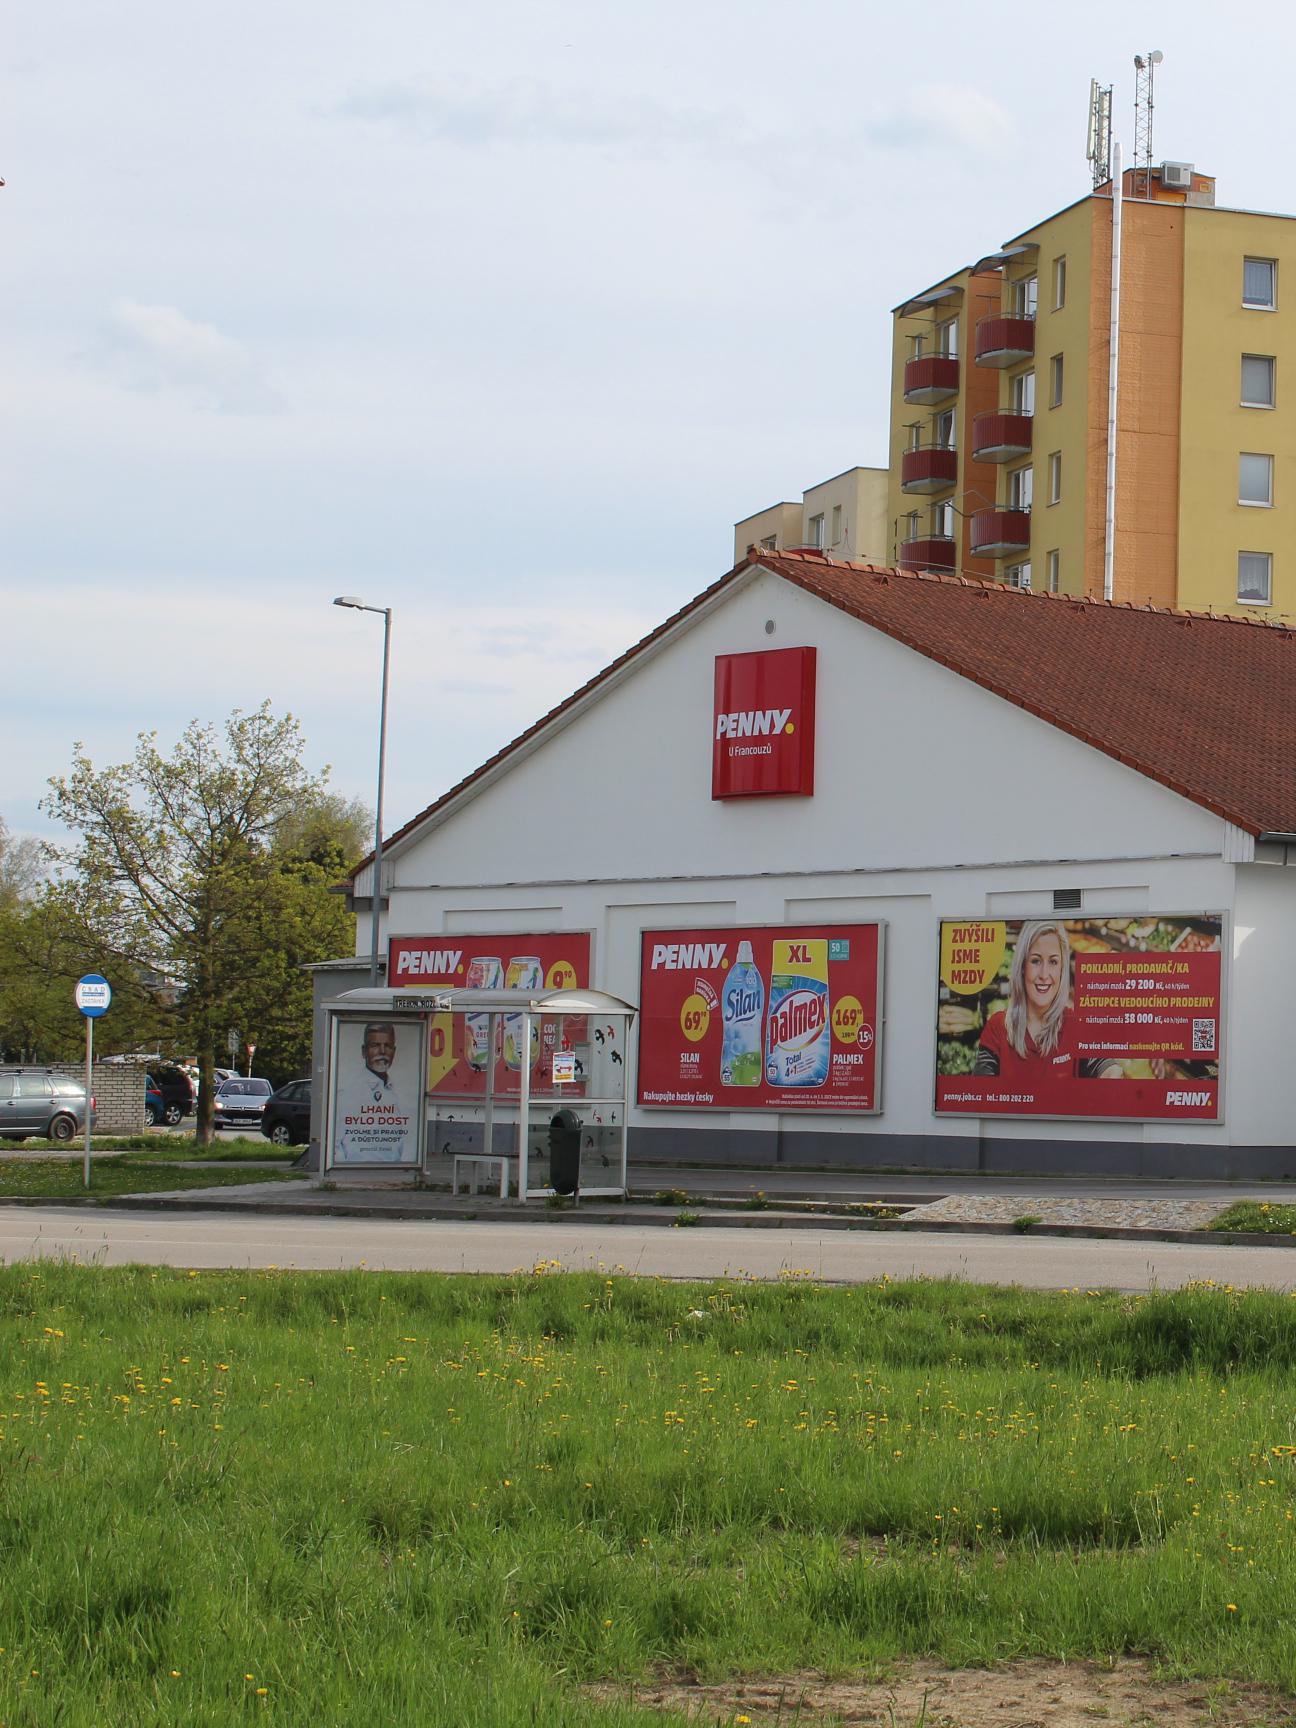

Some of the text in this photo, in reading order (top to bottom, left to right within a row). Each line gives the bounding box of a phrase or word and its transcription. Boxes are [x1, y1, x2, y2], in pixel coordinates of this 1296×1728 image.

[728, 743, 772, 756] U Francouzů
[951, 923, 995, 943] ZVÝŠILI
[788, 944, 812, 963] XL
[951, 948, 981, 964] JSME
[1080, 961, 1190, 975] POKLADNÍ, PRODAVAČ/KA
[951, 969, 985, 984] MZDY
[1125, 979, 1136, 989] 29
[1138, 979, 1154, 989] 200
[725, 988, 760, 1022] Silan
[1079, 995, 1214, 1008] ZÁSTUPCE VEDOUCÍHO PRODEJNY
[770, 993, 826, 1054] palmex
[1124, 1013, 1135, 1023] 38
[1136, 1013, 1154, 1023] 000
[1078, 1042, 1088, 1050] Pro
[1089, 1042, 1101, 1050] více
[1101, 1042, 1129, 1050] informací
[1161, 1043, 1170, 1051] QR
[1170, 1042, 1184, 1050] kód.
[680, 1053, 700, 1063] SILAN
[785, 1051, 802, 1066] Total
[832, 1054, 864, 1065] PALMEX
[643, 1091, 714, 1104] Nakupujte hezky česky
[360, 1104, 395, 1113] LHANÍ
[345, 1116, 410, 1125] BYLO DOST
